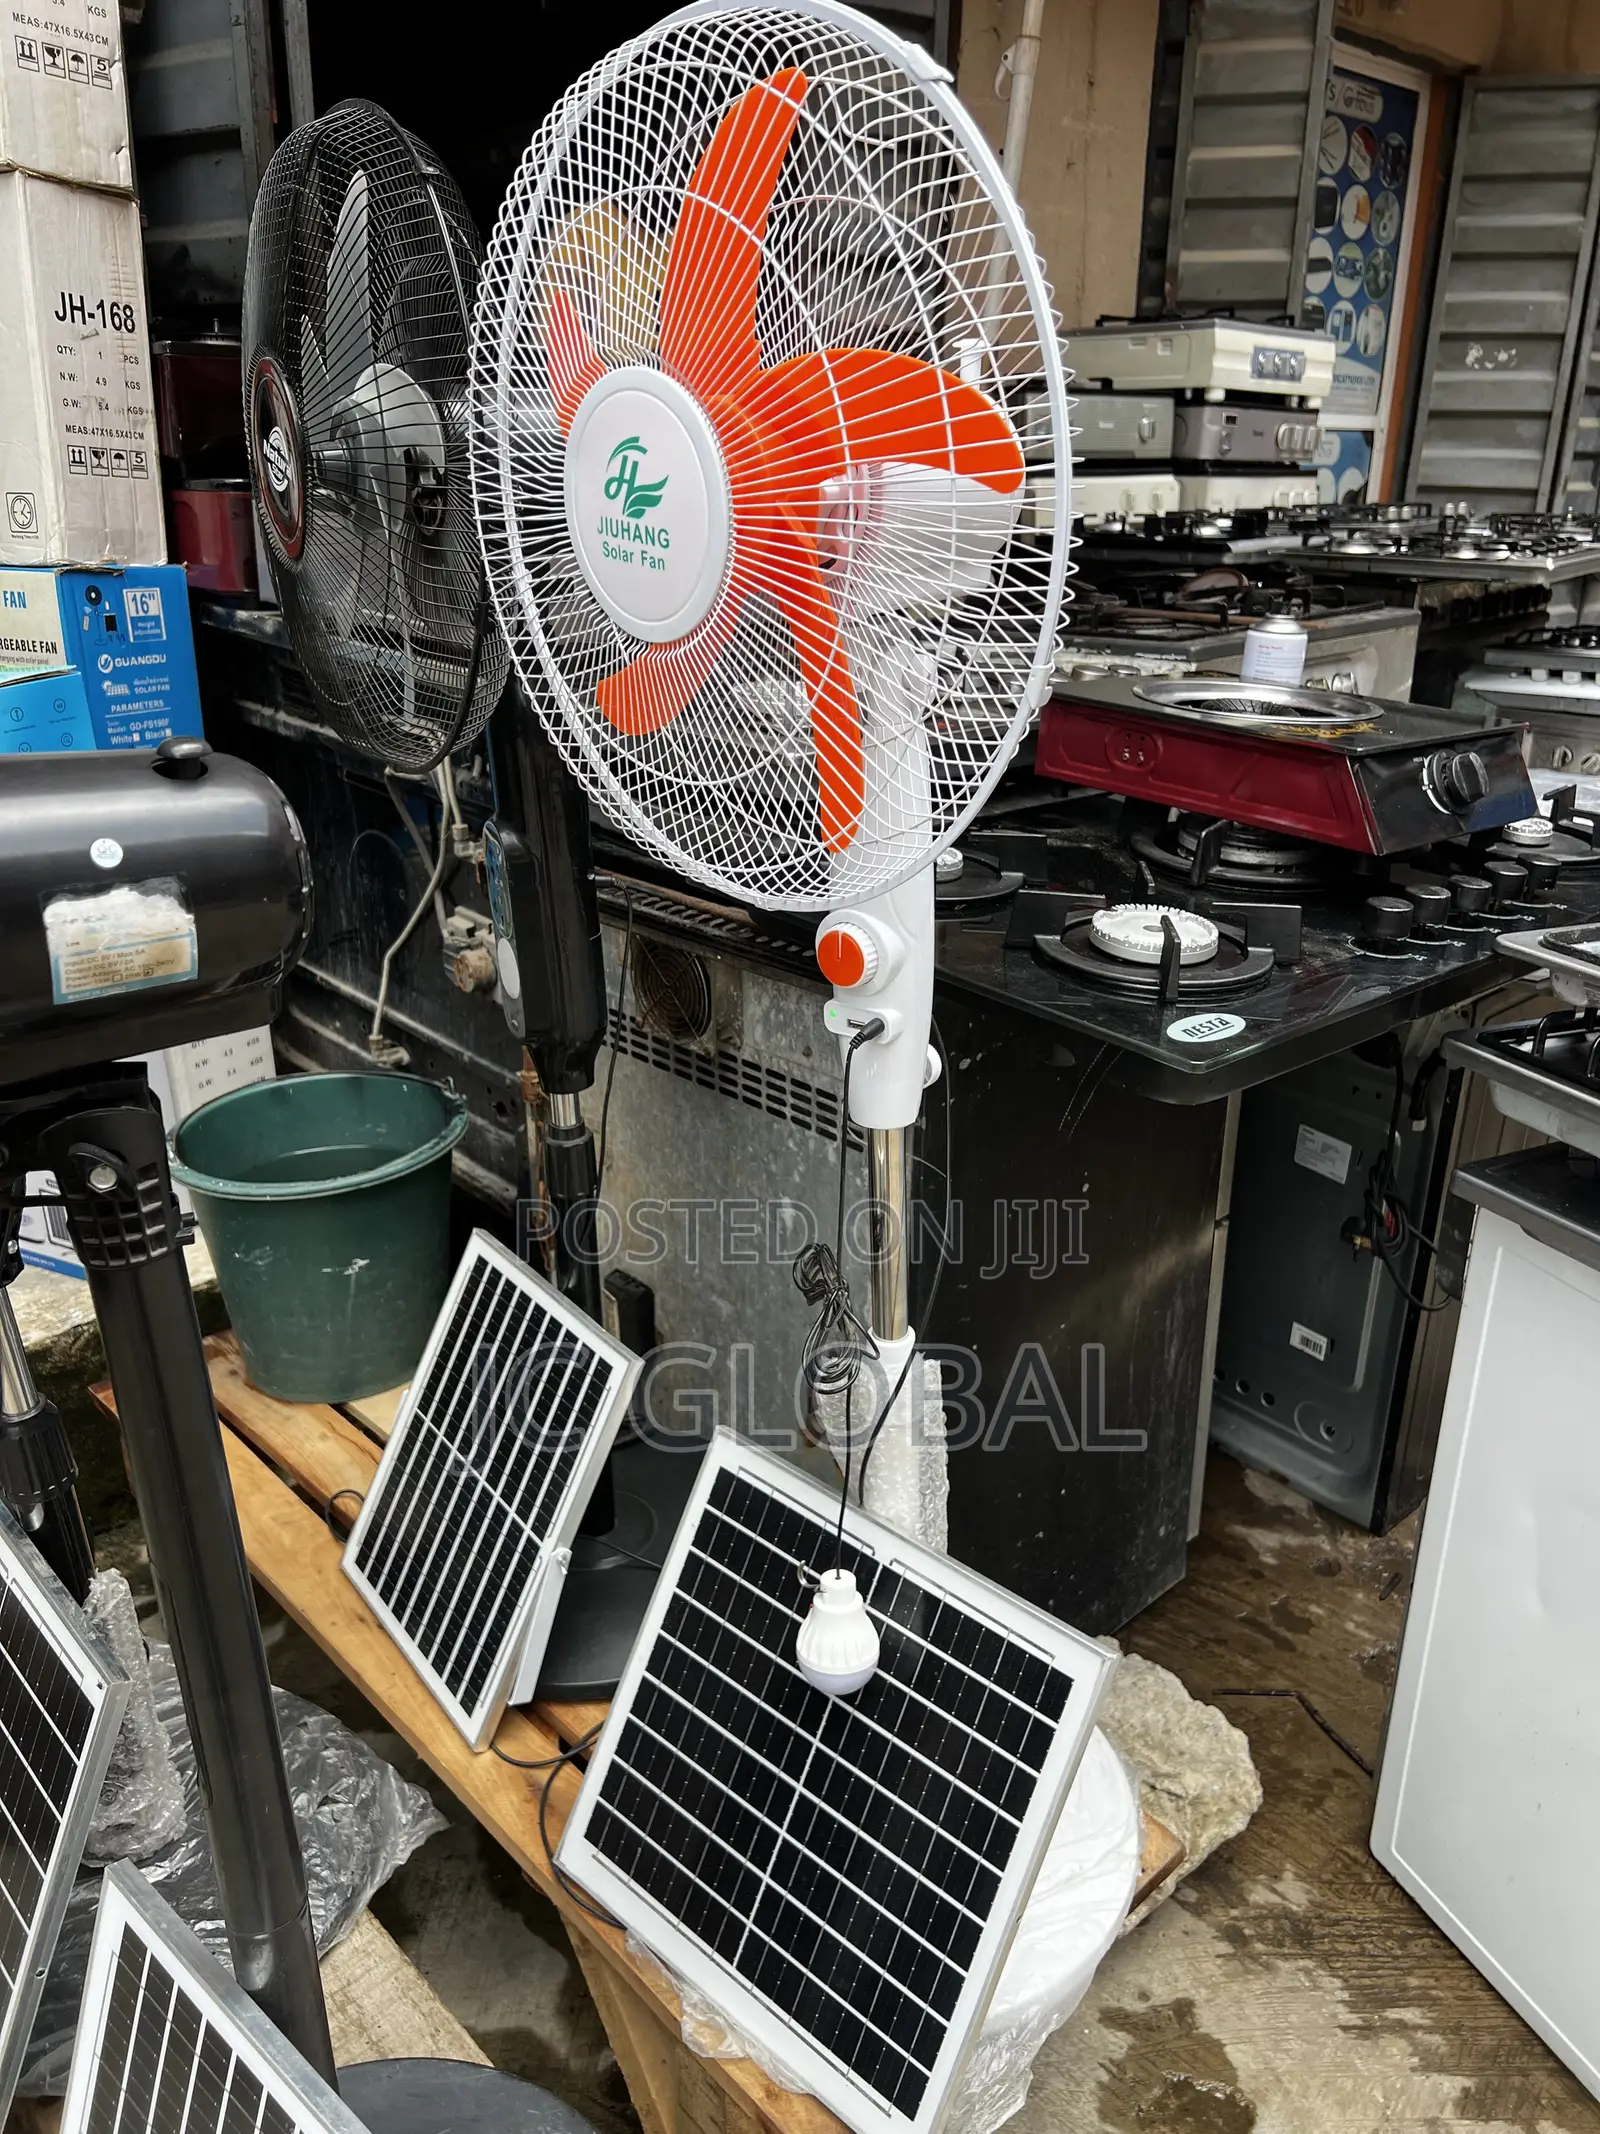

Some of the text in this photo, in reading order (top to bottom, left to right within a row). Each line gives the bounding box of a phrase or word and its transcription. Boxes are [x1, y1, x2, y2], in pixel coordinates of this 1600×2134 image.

[87, 5, 107, 18] KGS
[97, 59, 106, 71] 5
[54, 291, 136, 333] JH-168
[56, 345, 139, 365] QTY: 1 PCS
[59, 371, 141, 390] N.W: 4.9 KGS
[62, 398, 144, 416] G.W: 5.4 KGS
[135, 452, 144, 464] 5
[597, 516, 670, 549] JIUHANG
[602, 541, 665, 571] Solar Fan
[3, 590, 27, 609] FAN
[39, 640, 58, 654] FAN
[114, 654, 167, 667] GUANGDU
[134, 683, 170, 695] SOLAR FAN
[111, 699, 164, 713] PARAMETERS
[111, 729, 165, 745] White Black
